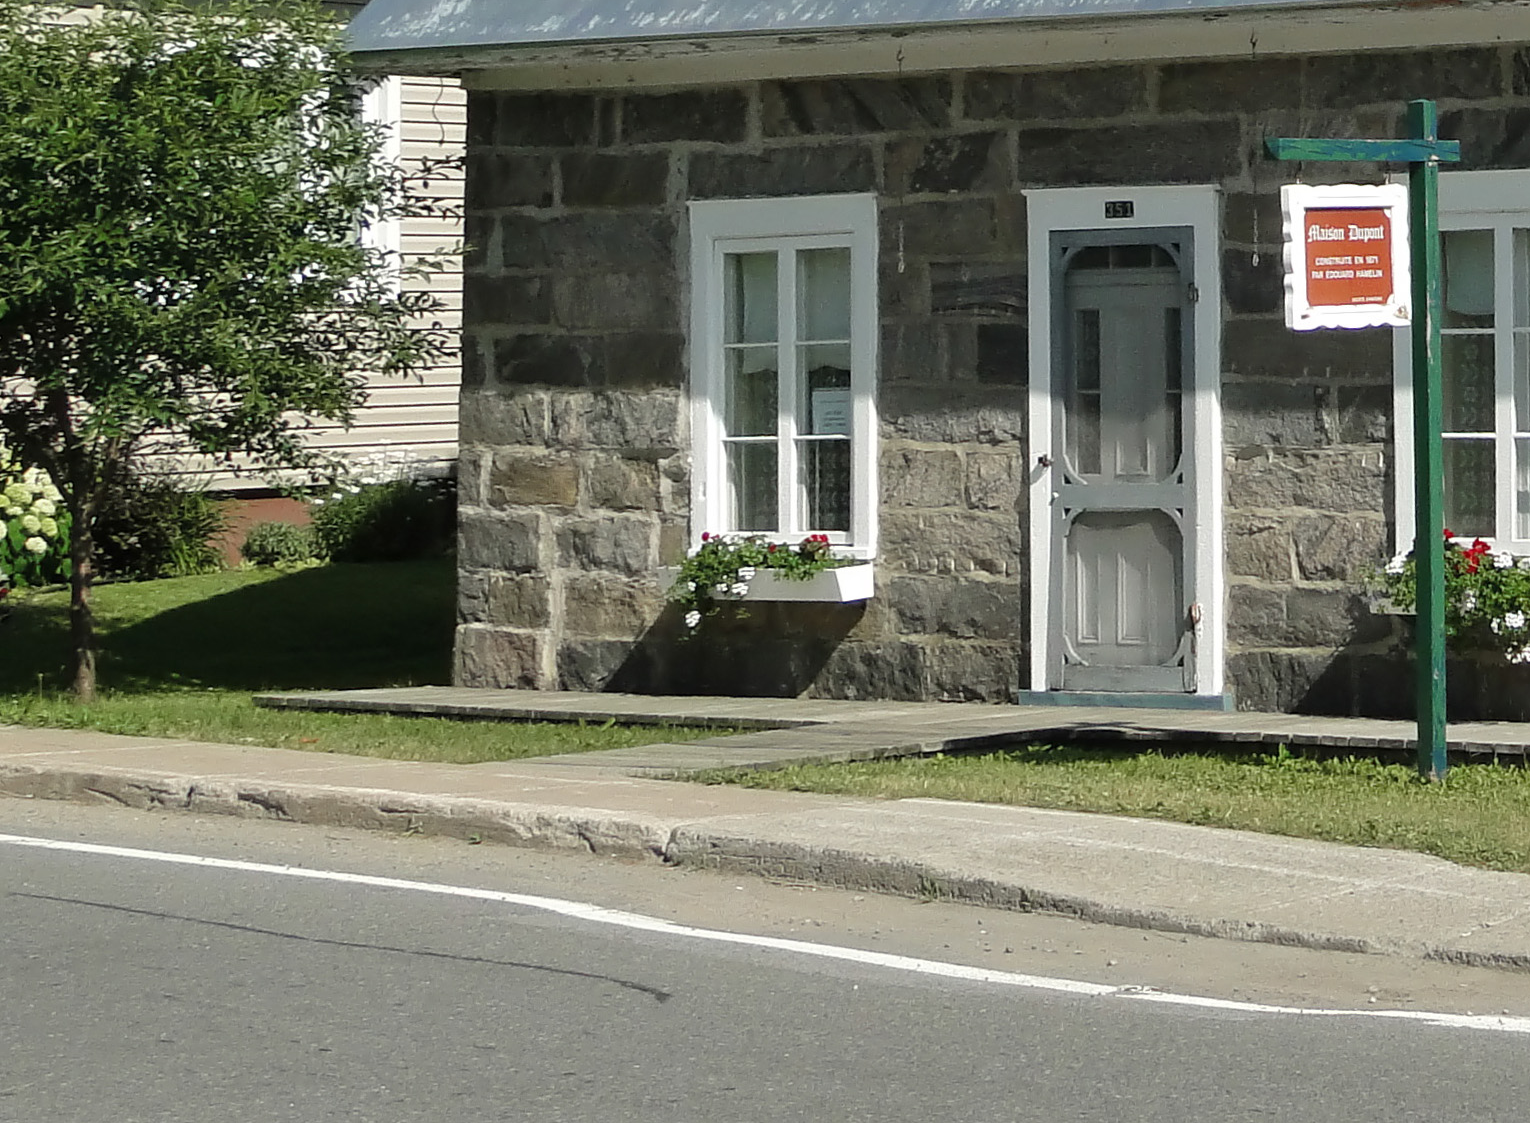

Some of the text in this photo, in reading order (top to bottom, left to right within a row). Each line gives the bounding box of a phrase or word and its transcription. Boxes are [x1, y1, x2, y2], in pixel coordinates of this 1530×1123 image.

[1106, 202, 1132, 217] 351
[1307, 224, 1384, 243] Maison Dupont
